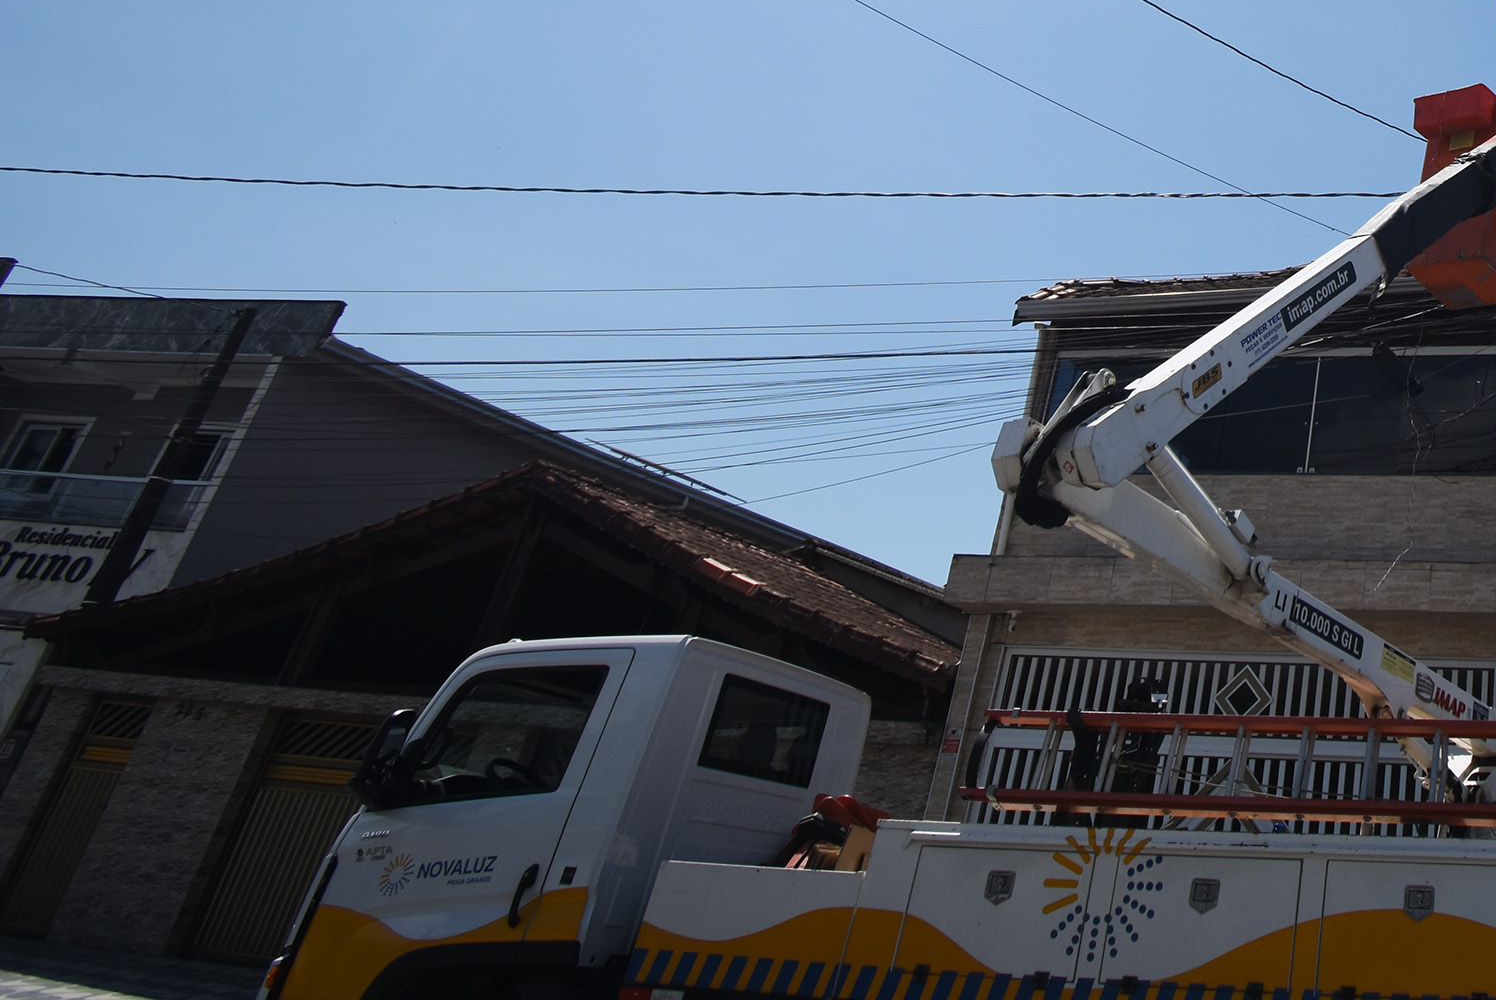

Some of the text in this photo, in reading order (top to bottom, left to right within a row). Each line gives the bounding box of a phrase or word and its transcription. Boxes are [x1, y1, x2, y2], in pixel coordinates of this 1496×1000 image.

[1286, 269, 1350, 323] imap.com.br
[1240, 323, 1268, 348] POWER
[1194, 366, 1219, 391] JBS
[14, 526, 119, 549] Residencial
[1294, 602, 1331, 637] 10.000
[1331, 624, 1341, 643] S
[417, 855, 498, 879] NOVALUZ
[446, 875, 492, 887] PRAIA GRANDE
